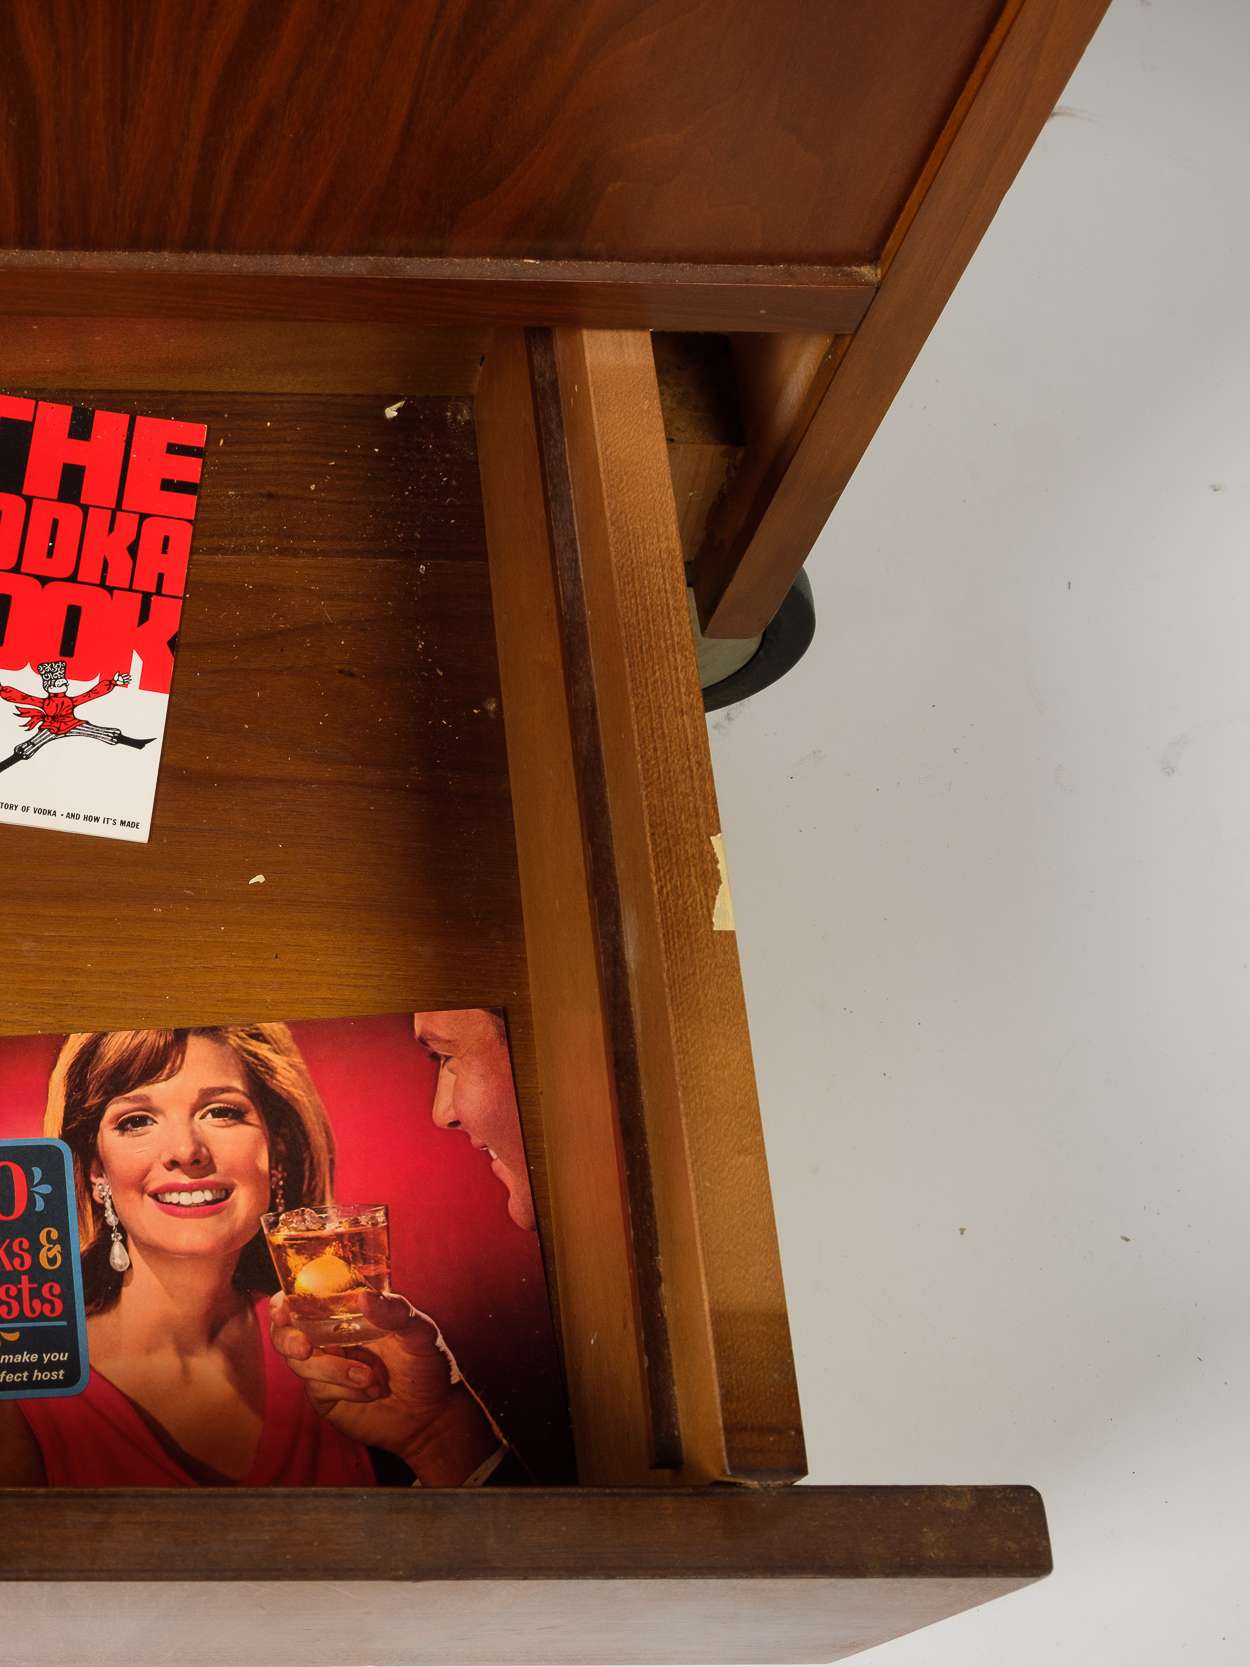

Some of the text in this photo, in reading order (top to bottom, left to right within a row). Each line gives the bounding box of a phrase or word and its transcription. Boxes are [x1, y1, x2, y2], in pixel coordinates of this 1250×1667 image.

[21, 804, 31, 813] OF
[33, 805, 58, 817] VODKA
[65, 811, 81, 820] AND
[83, 813, 101, 823] HOW
[102, 816, 118, 826] IT'S
[119, 818, 141, 830] MADE
[39, 1227, 62, 1270] &
[0, 1351, 38, 1364] make
[42, 1351, 68, 1366] you
[32, 1368, 64, 1380] host
